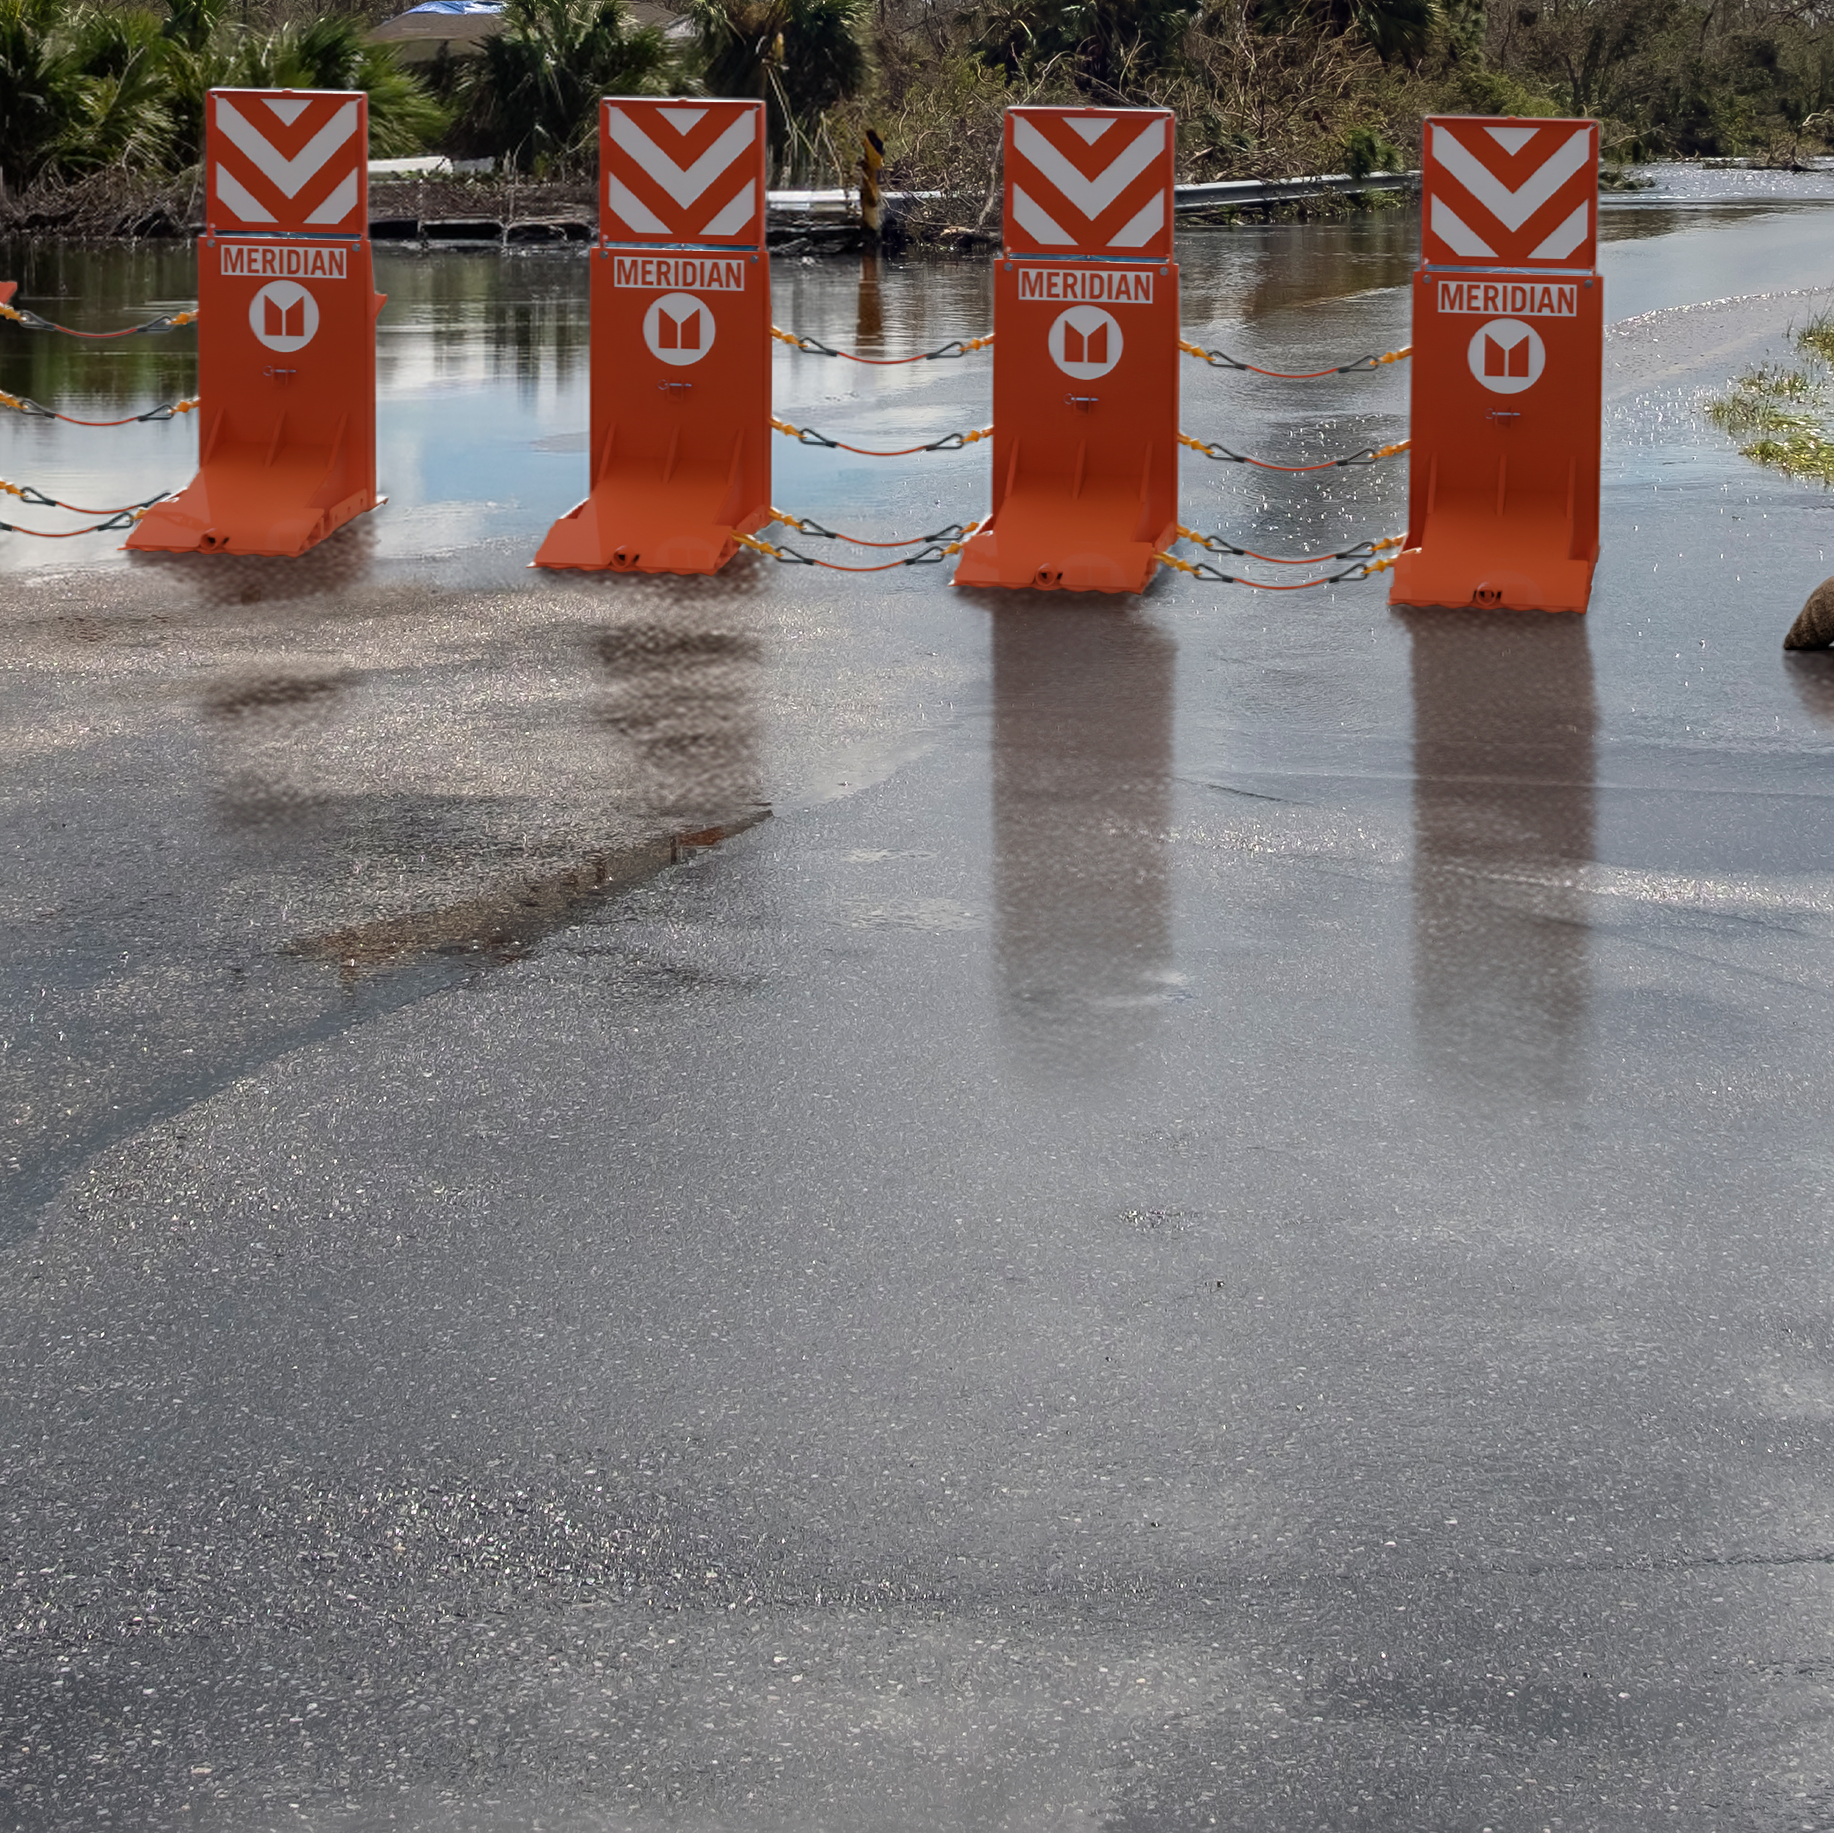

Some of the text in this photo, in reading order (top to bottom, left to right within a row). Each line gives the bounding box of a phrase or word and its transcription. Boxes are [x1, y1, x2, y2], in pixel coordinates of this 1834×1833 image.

[224, 248, 343, 276] MERIDIAN
[617, 259, 741, 288] MERIDIAN
[1022, 271, 1150, 300] MERIDIAN
[1441, 284, 1574, 313] MERIDIAN
